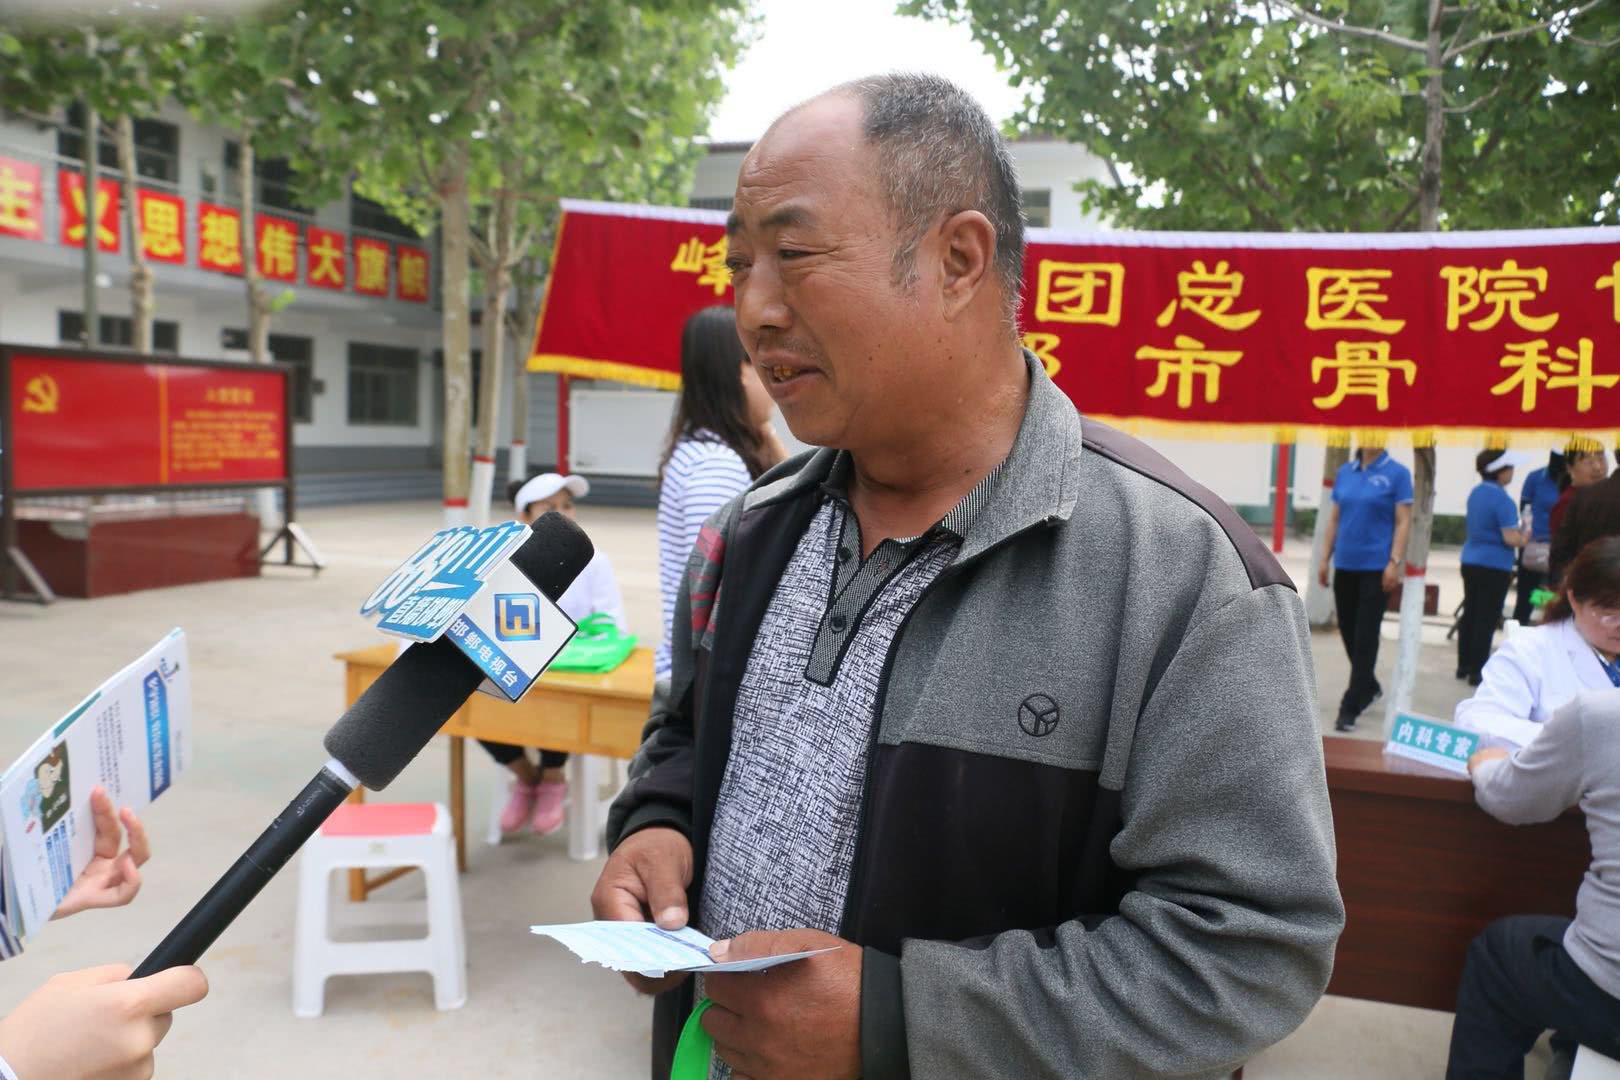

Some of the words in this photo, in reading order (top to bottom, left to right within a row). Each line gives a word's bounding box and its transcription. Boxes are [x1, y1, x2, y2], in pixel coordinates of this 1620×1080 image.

[1034, 259, 1620, 334] 团总医院
[1020, 333, 1619, 412] 市骨科
[451, 618, 519, 688] 邯郸电视台
[1397, 721, 1473, 759] 内科专家
